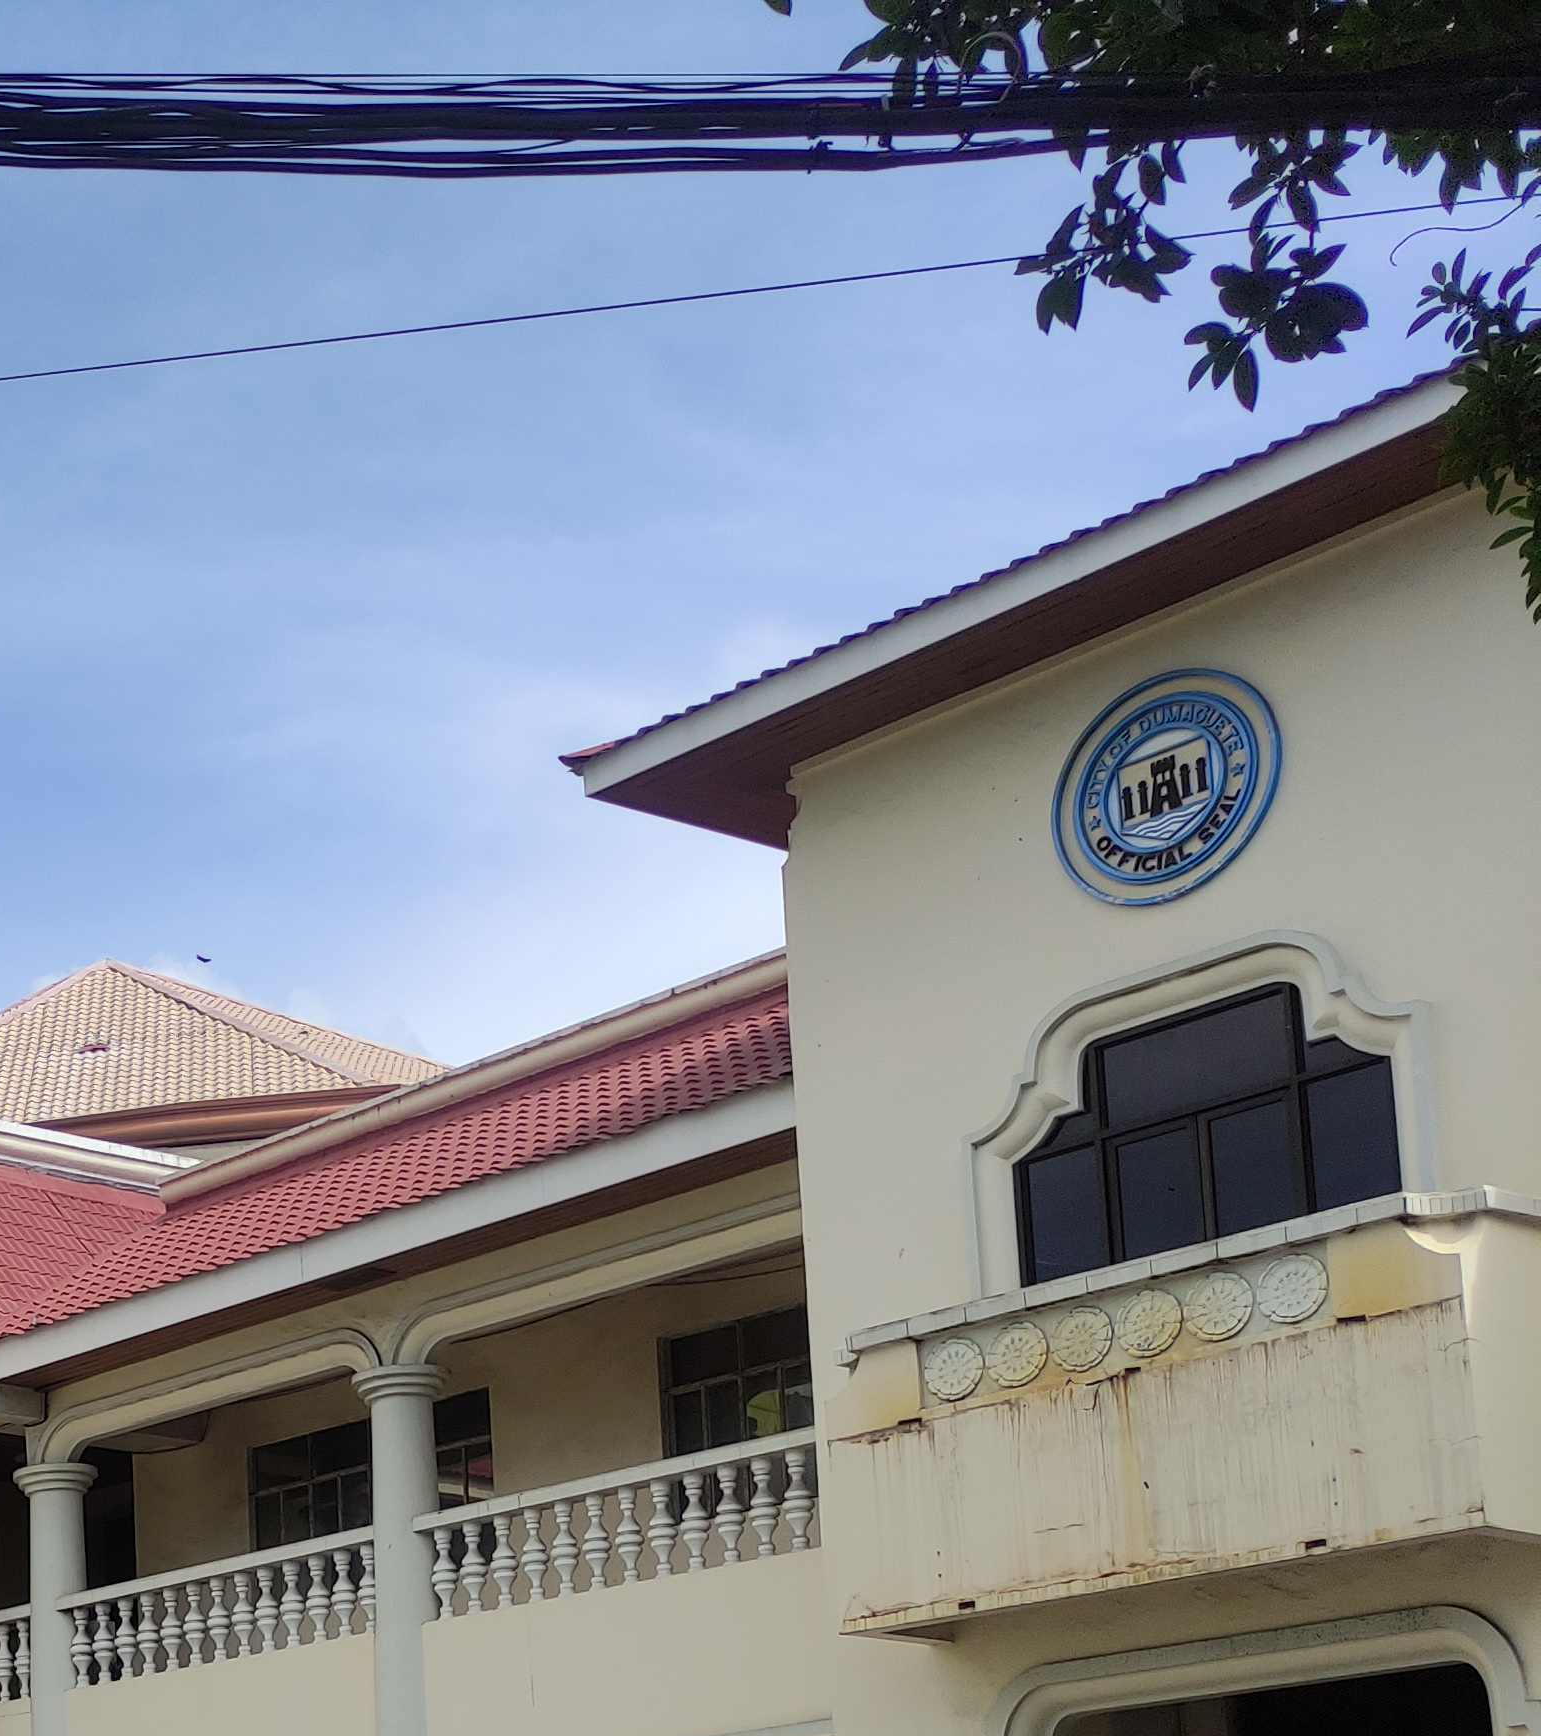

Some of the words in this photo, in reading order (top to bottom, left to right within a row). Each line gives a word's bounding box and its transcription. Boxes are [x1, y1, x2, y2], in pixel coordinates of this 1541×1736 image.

[1087, 757, 1112, 809] CITY
[1110, 728, 1133, 761] OF
[1138, 703, 1246, 757] DUMAGUETE
[1096, 835, 1194, 873] OFFICIAL
[1197, 787, 1242, 845] SEAL
